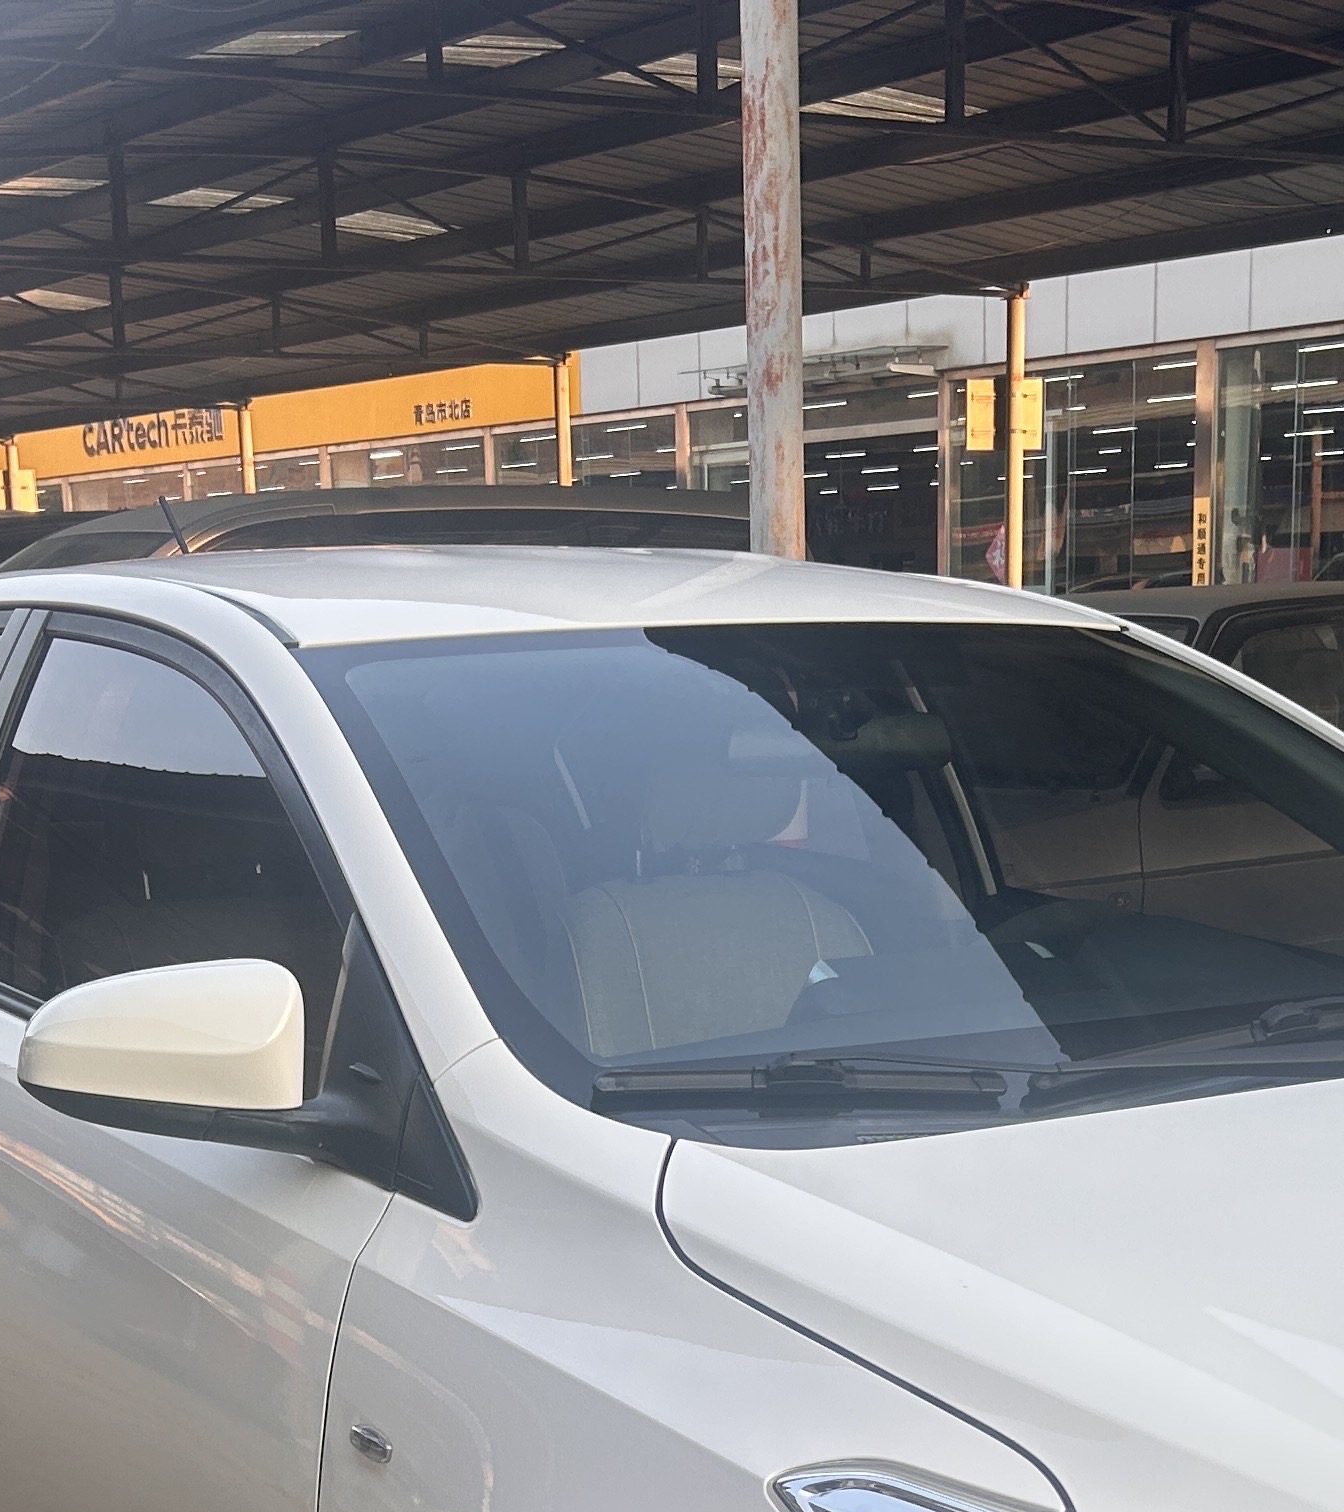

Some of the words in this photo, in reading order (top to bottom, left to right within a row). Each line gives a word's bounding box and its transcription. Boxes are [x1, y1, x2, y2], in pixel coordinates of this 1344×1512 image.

[413, 398, 471, 426] 青岛市北店
